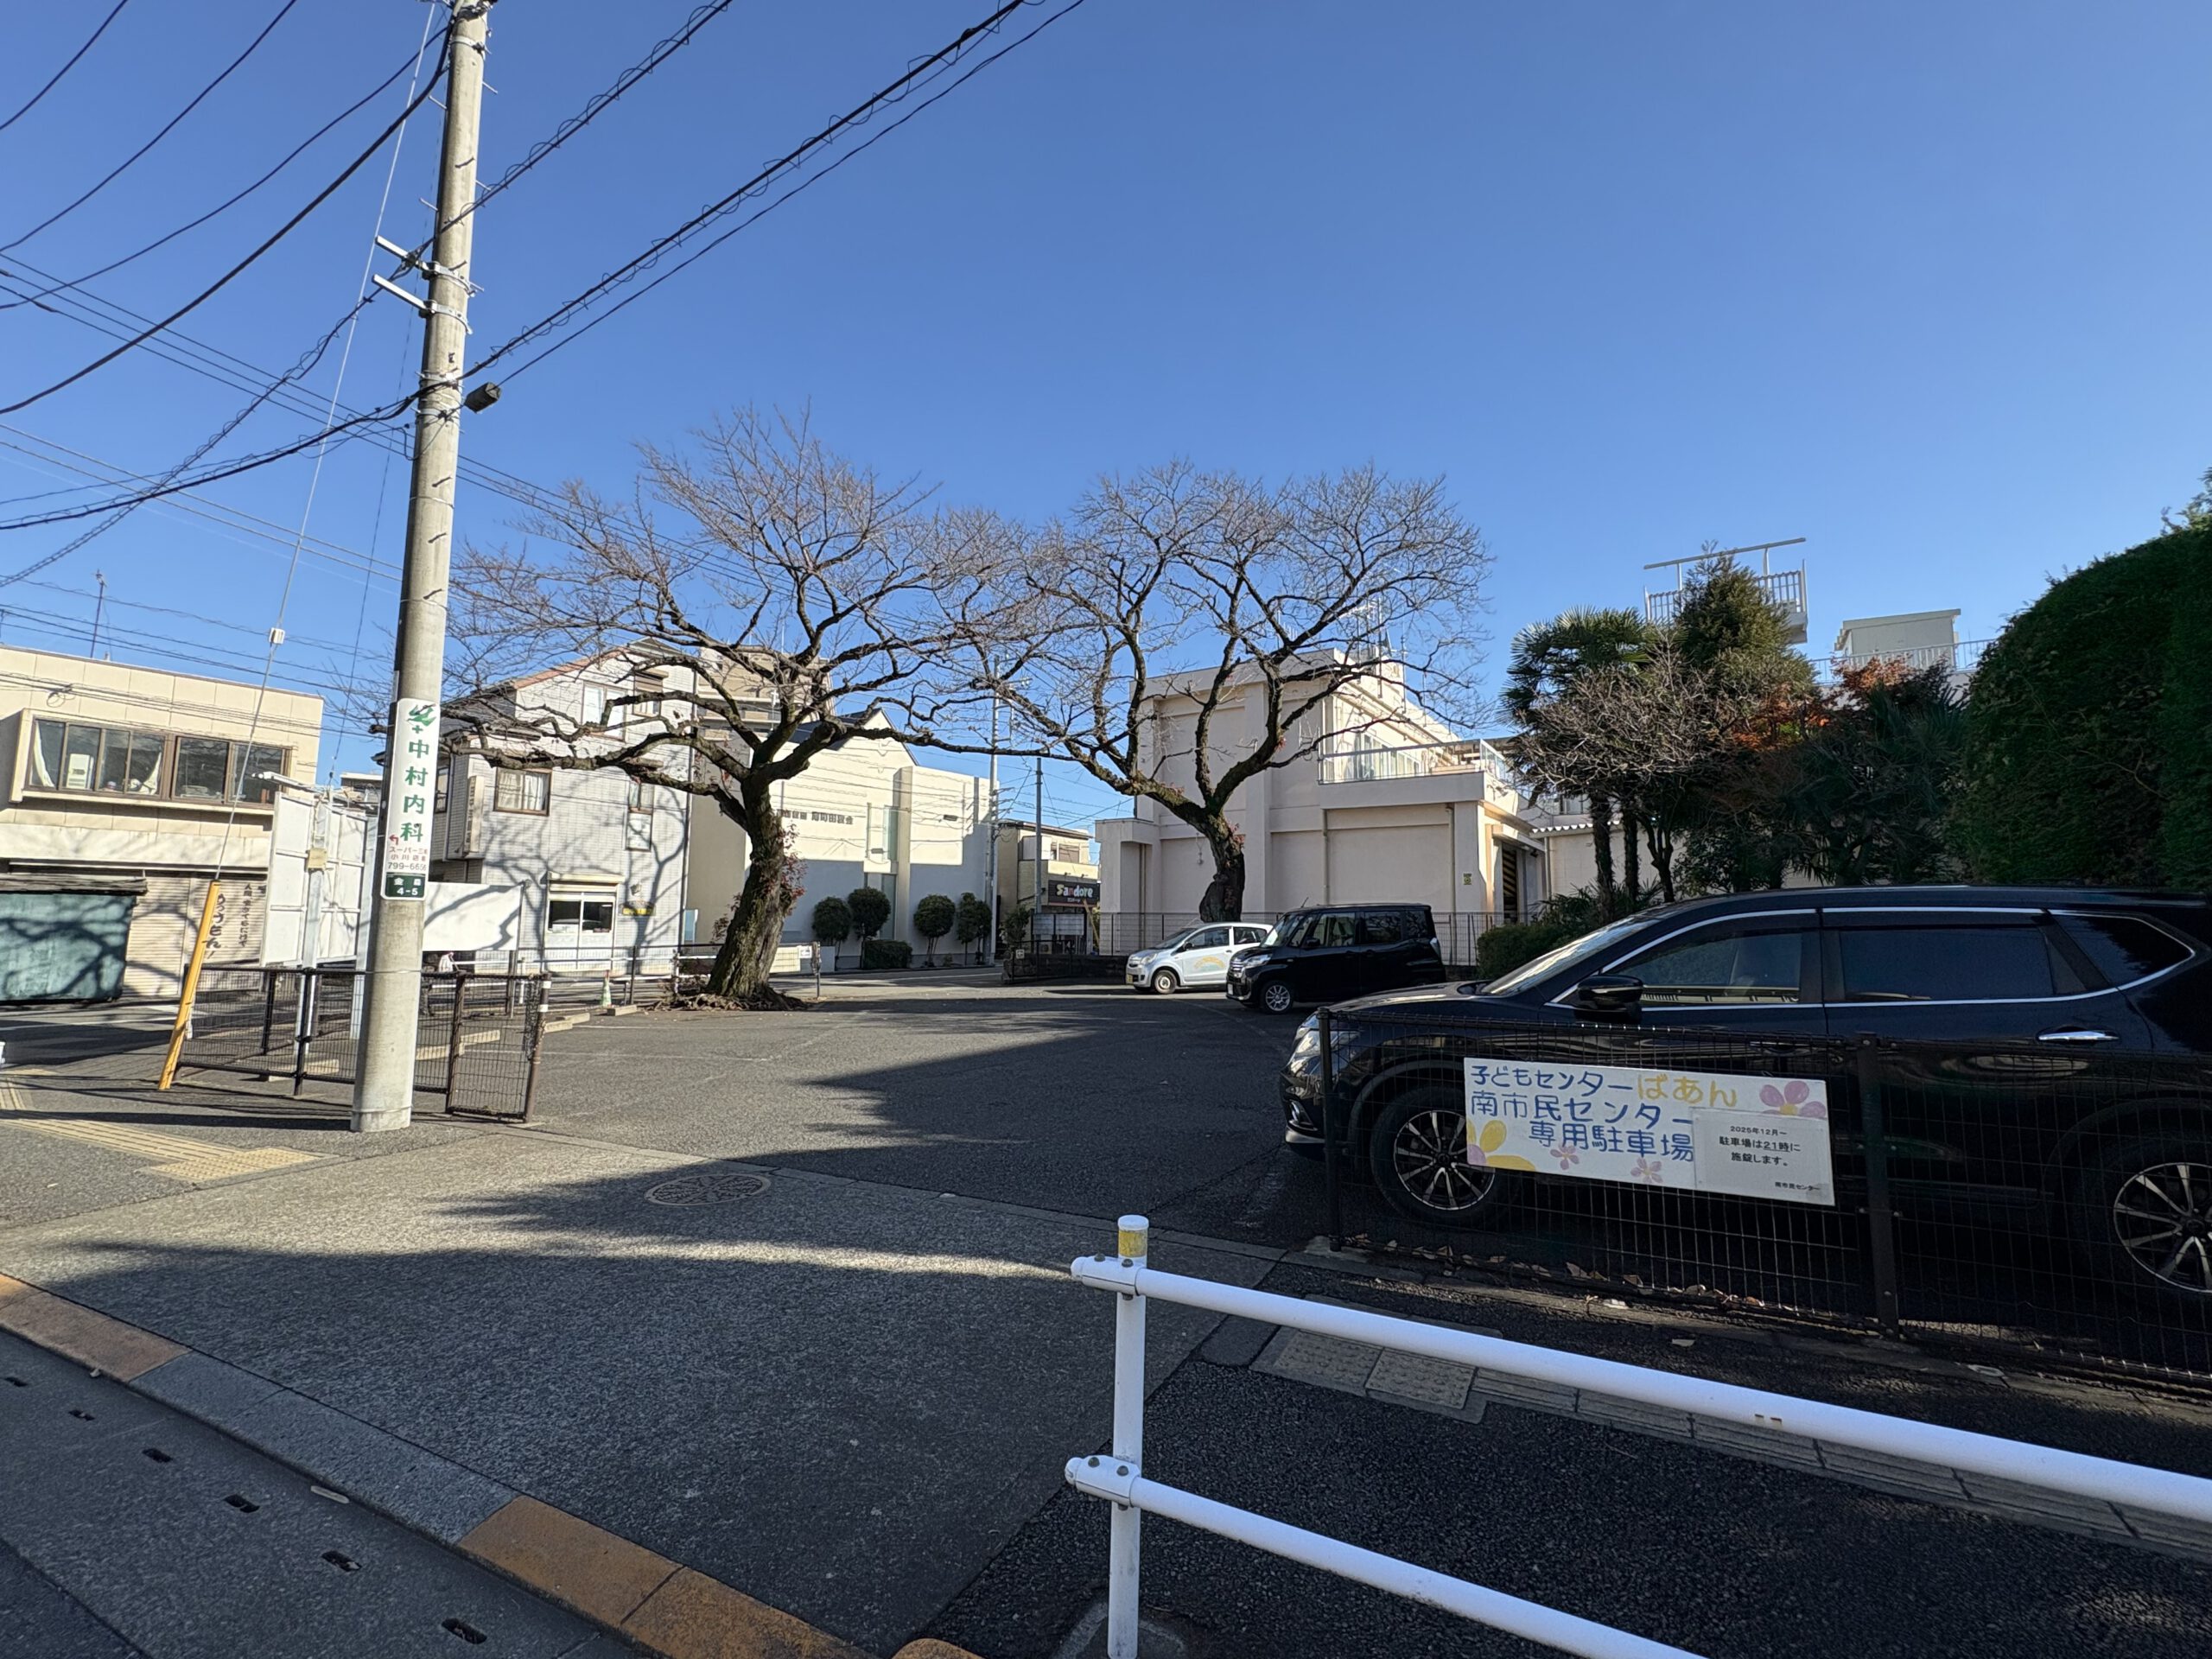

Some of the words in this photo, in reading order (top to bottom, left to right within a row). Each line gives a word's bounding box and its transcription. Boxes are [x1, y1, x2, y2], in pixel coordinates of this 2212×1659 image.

[400, 740, 429, 842] 中村内科
[397, 887, 418, 896] 4-5
[1057, 883, 1094, 898] Sandore
[1471, 1090, 1694, 1130] 南市民センター
[1528, 1120, 1694, 1162] 専用駐車場
[1719, 1135, 1802, 1152] 駐車場は21時に
[1731, 1152, 1788, 1166] 施錠します。
